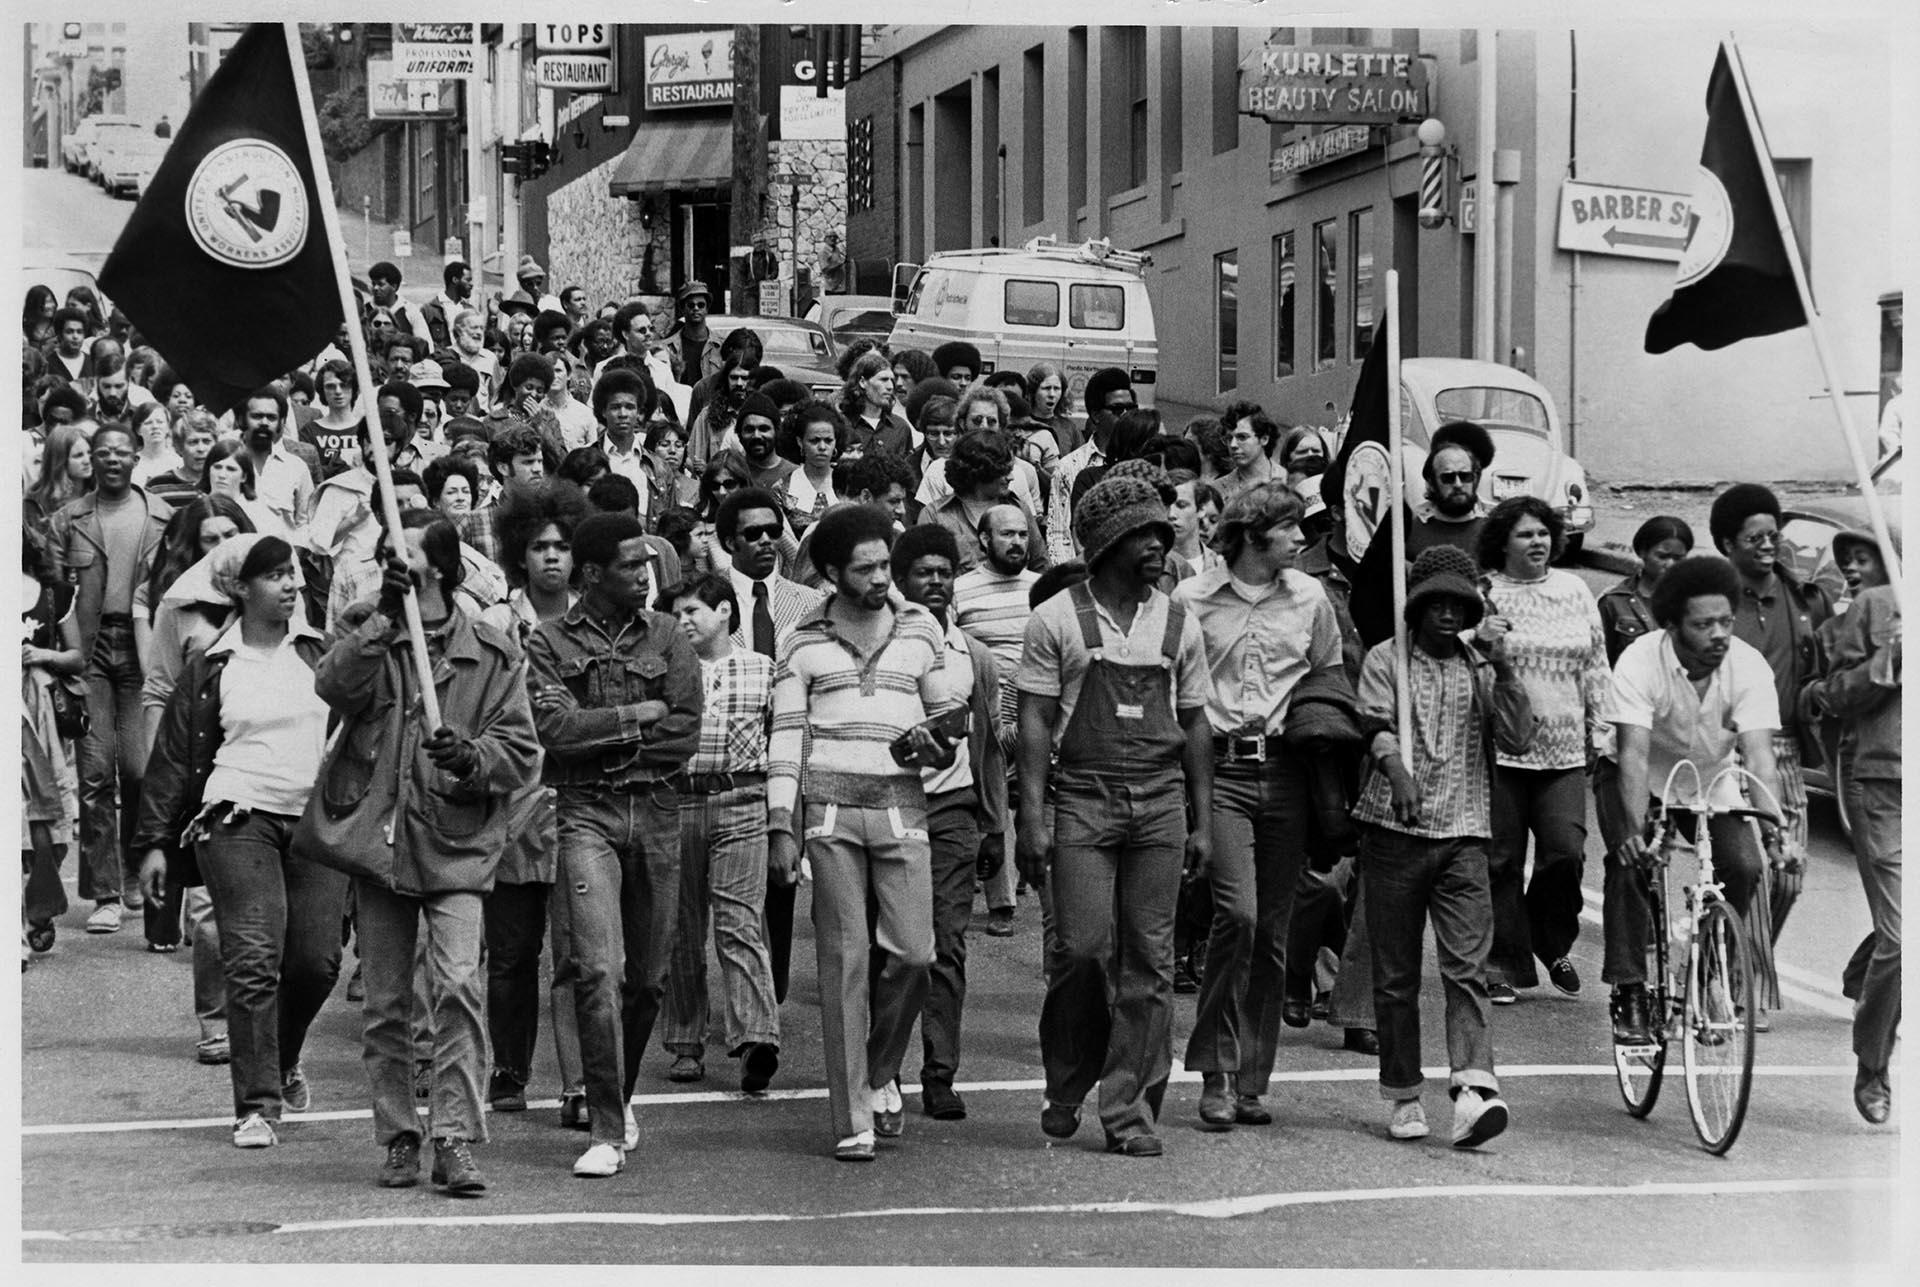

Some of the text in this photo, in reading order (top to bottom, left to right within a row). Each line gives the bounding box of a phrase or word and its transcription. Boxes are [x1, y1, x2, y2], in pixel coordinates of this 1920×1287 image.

[548, 24, 604, 43] TOPS
[543, 62, 608, 83] RESTAURANT
[1262, 52, 1409, 77] KURLETTE
[652, 82, 734, 102] RESTAURAN
[1249, 87, 1418, 112] BEAUTY SALON
[1571, 194, 1691, 228] BARBER S
[210, 234, 269, 258] WORKERS
[316, 434, 359, 449] VOTE
